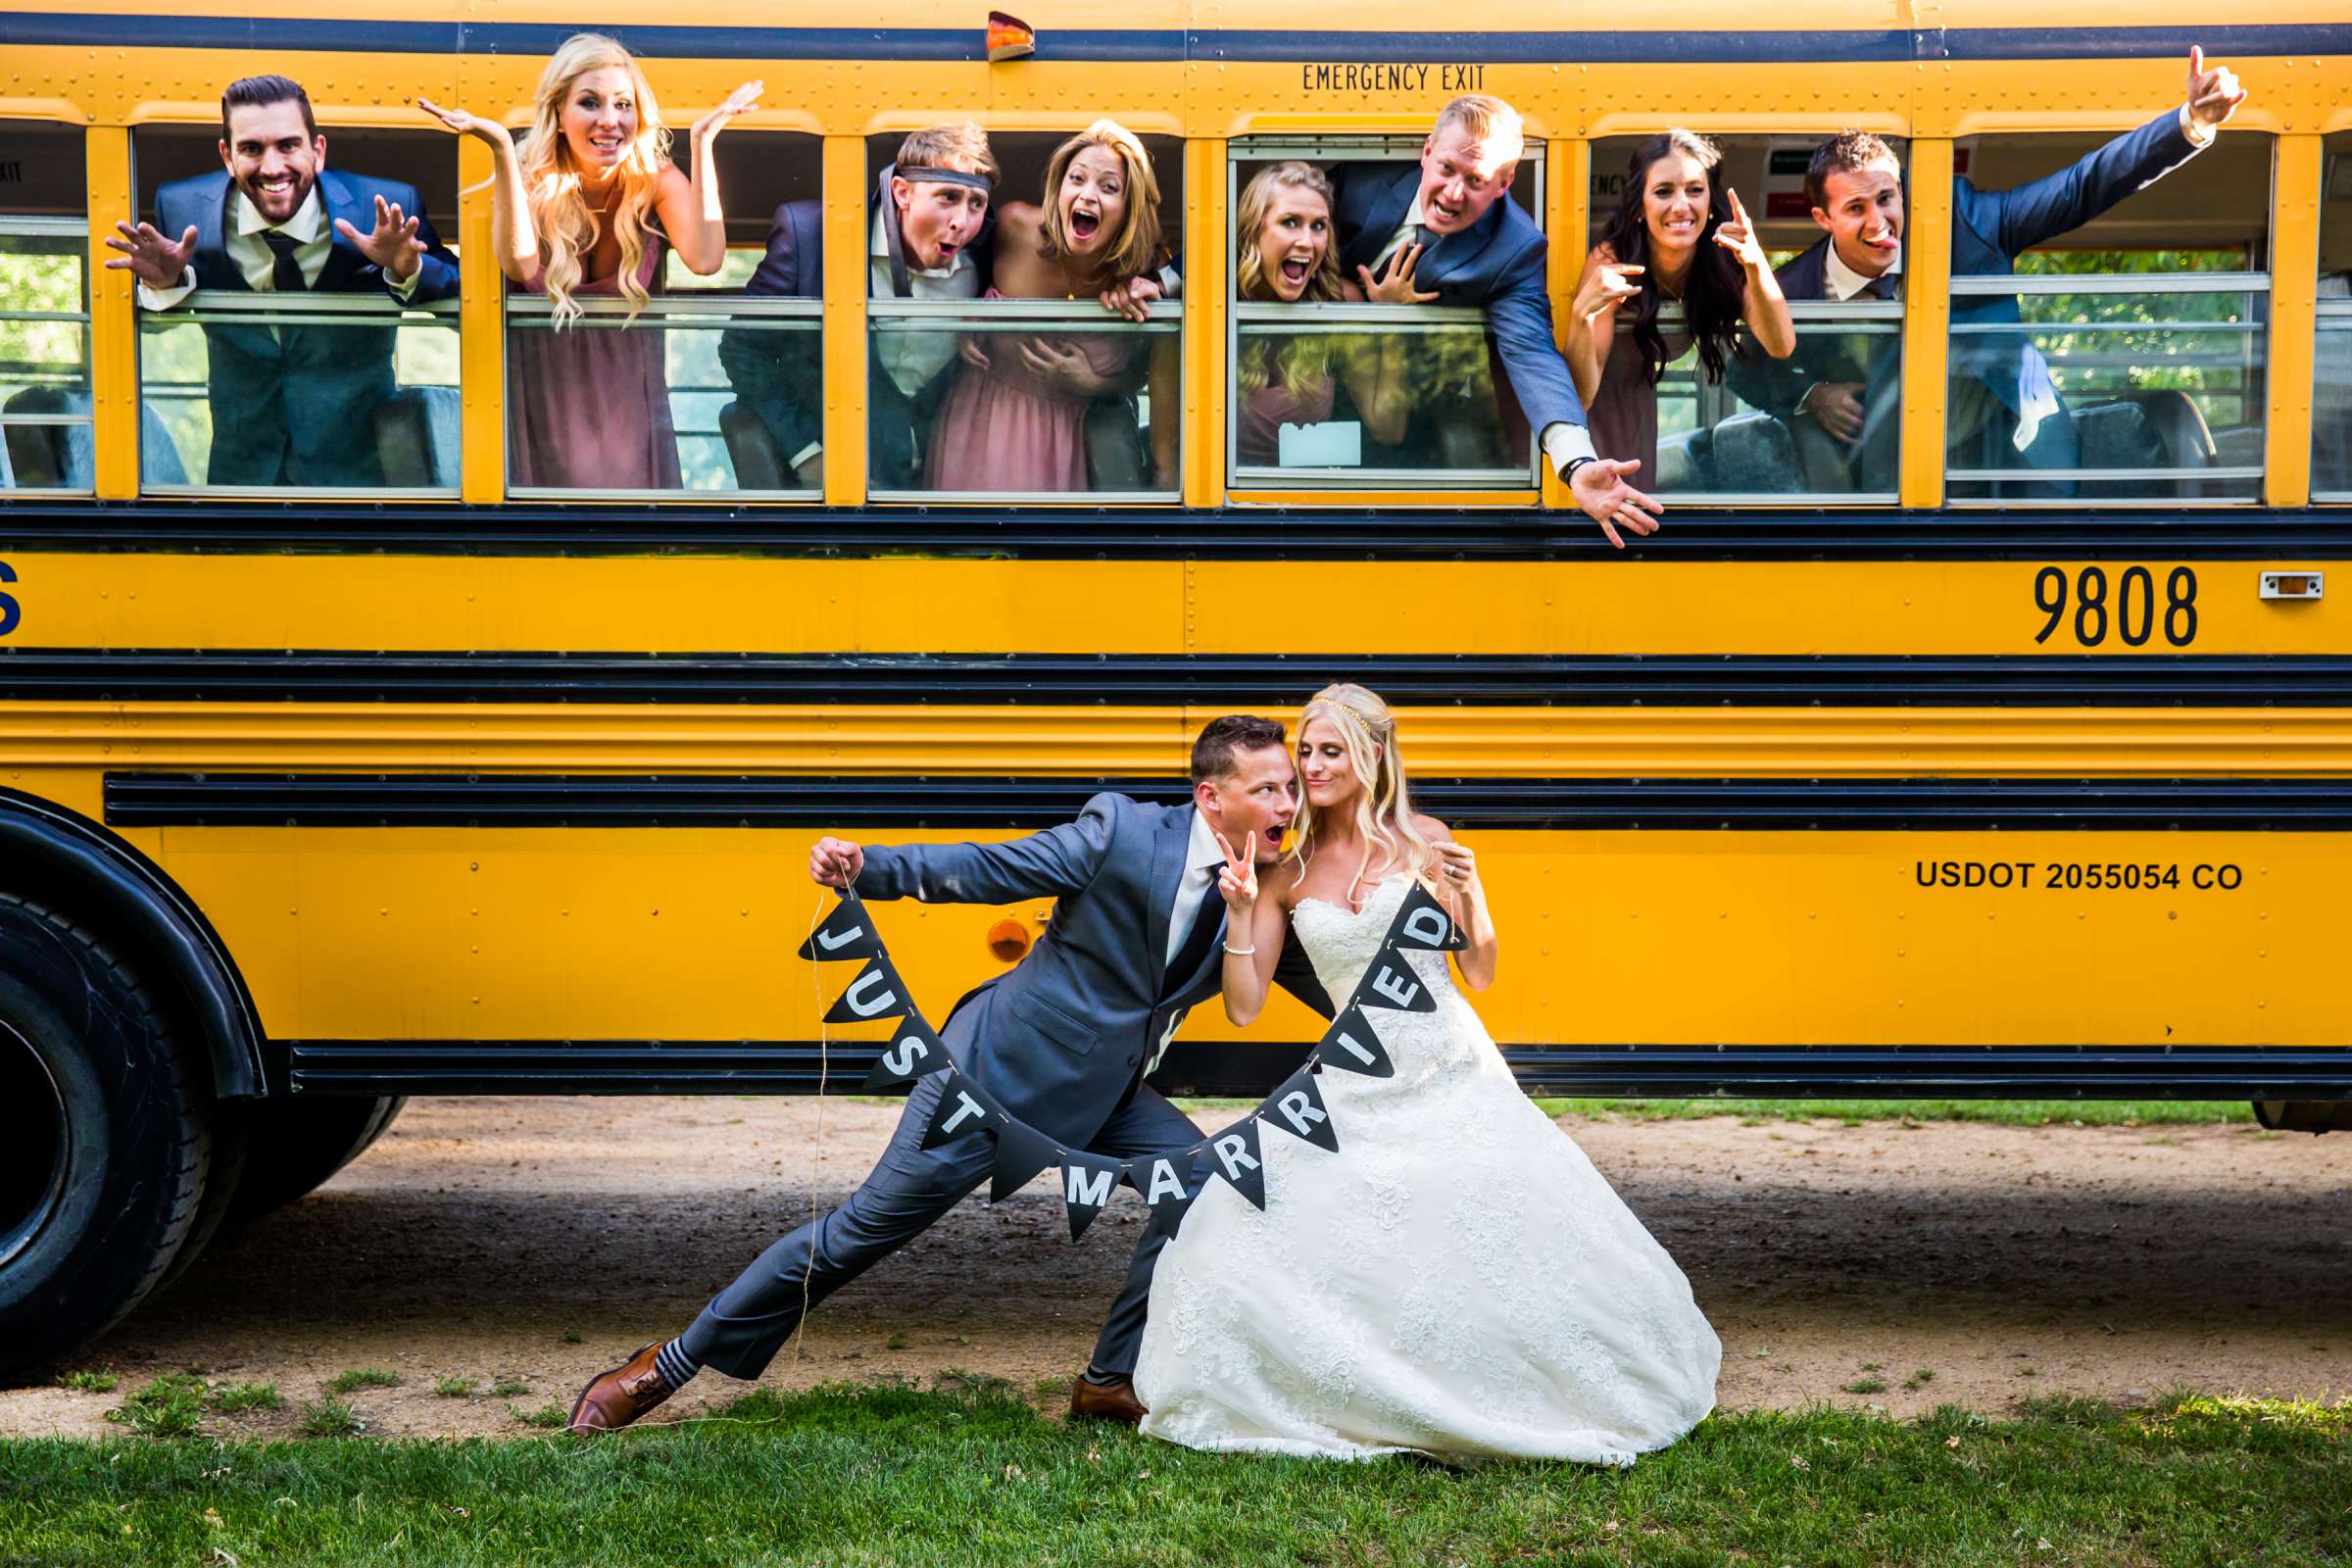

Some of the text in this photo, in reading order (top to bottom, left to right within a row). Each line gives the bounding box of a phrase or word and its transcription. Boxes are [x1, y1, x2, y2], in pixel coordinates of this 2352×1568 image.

[1303, 65, 1486, 91] EMERGENCY EXIT
[2034, 565, 2198, 648] 9808
[1916, 861, 2242, 890] USDOT 2055054 CO
[817, 906, 1448, 1207] JUST MARRIED
